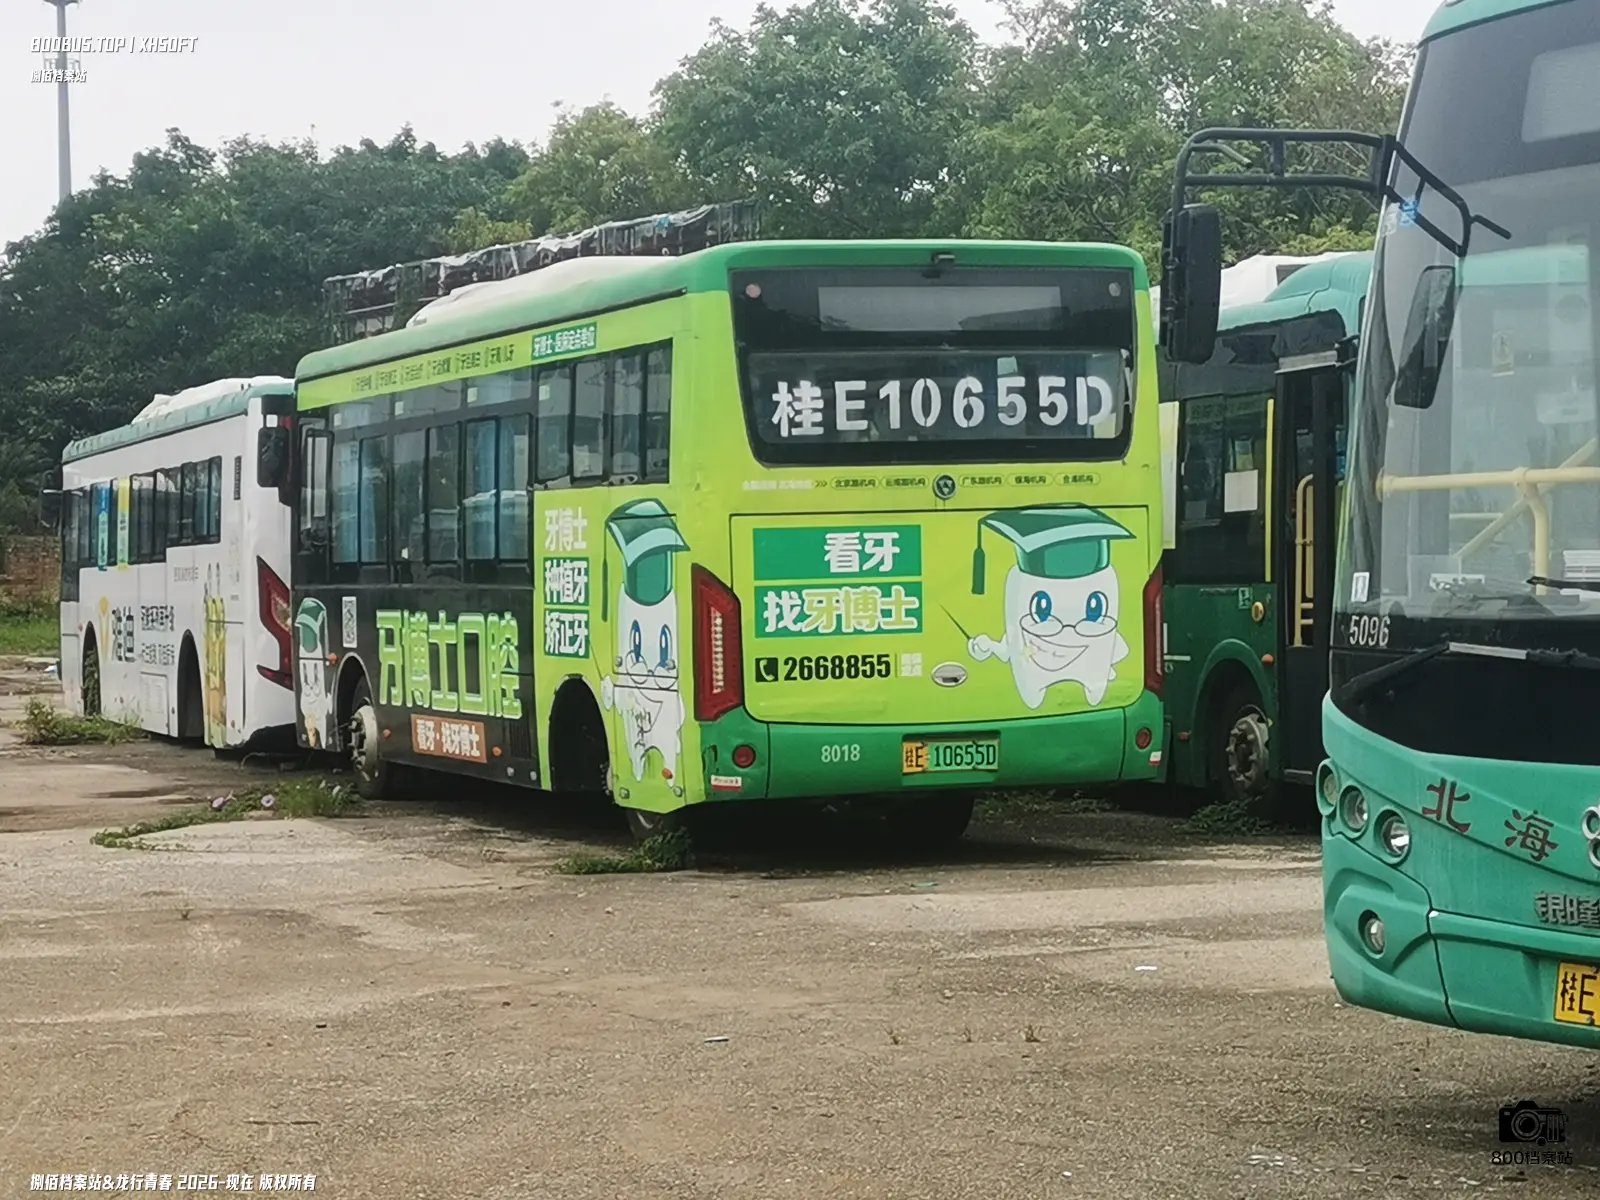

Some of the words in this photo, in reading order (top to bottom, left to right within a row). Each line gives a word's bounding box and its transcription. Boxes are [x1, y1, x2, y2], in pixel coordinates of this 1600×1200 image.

[545, 507, 588, 551] 牙博士
[824, 531, 900, 573] 看牙
[545, 559, 588, 603] 种植牙
[763, 585, 919, 633] 找牙博士
[1350, 615, 1390, 646] 5096
[545, 611, 588, 656] 矫正牙
[783, 654, 891, 681] 2668855
[821, 744, 860, 763] 8018
